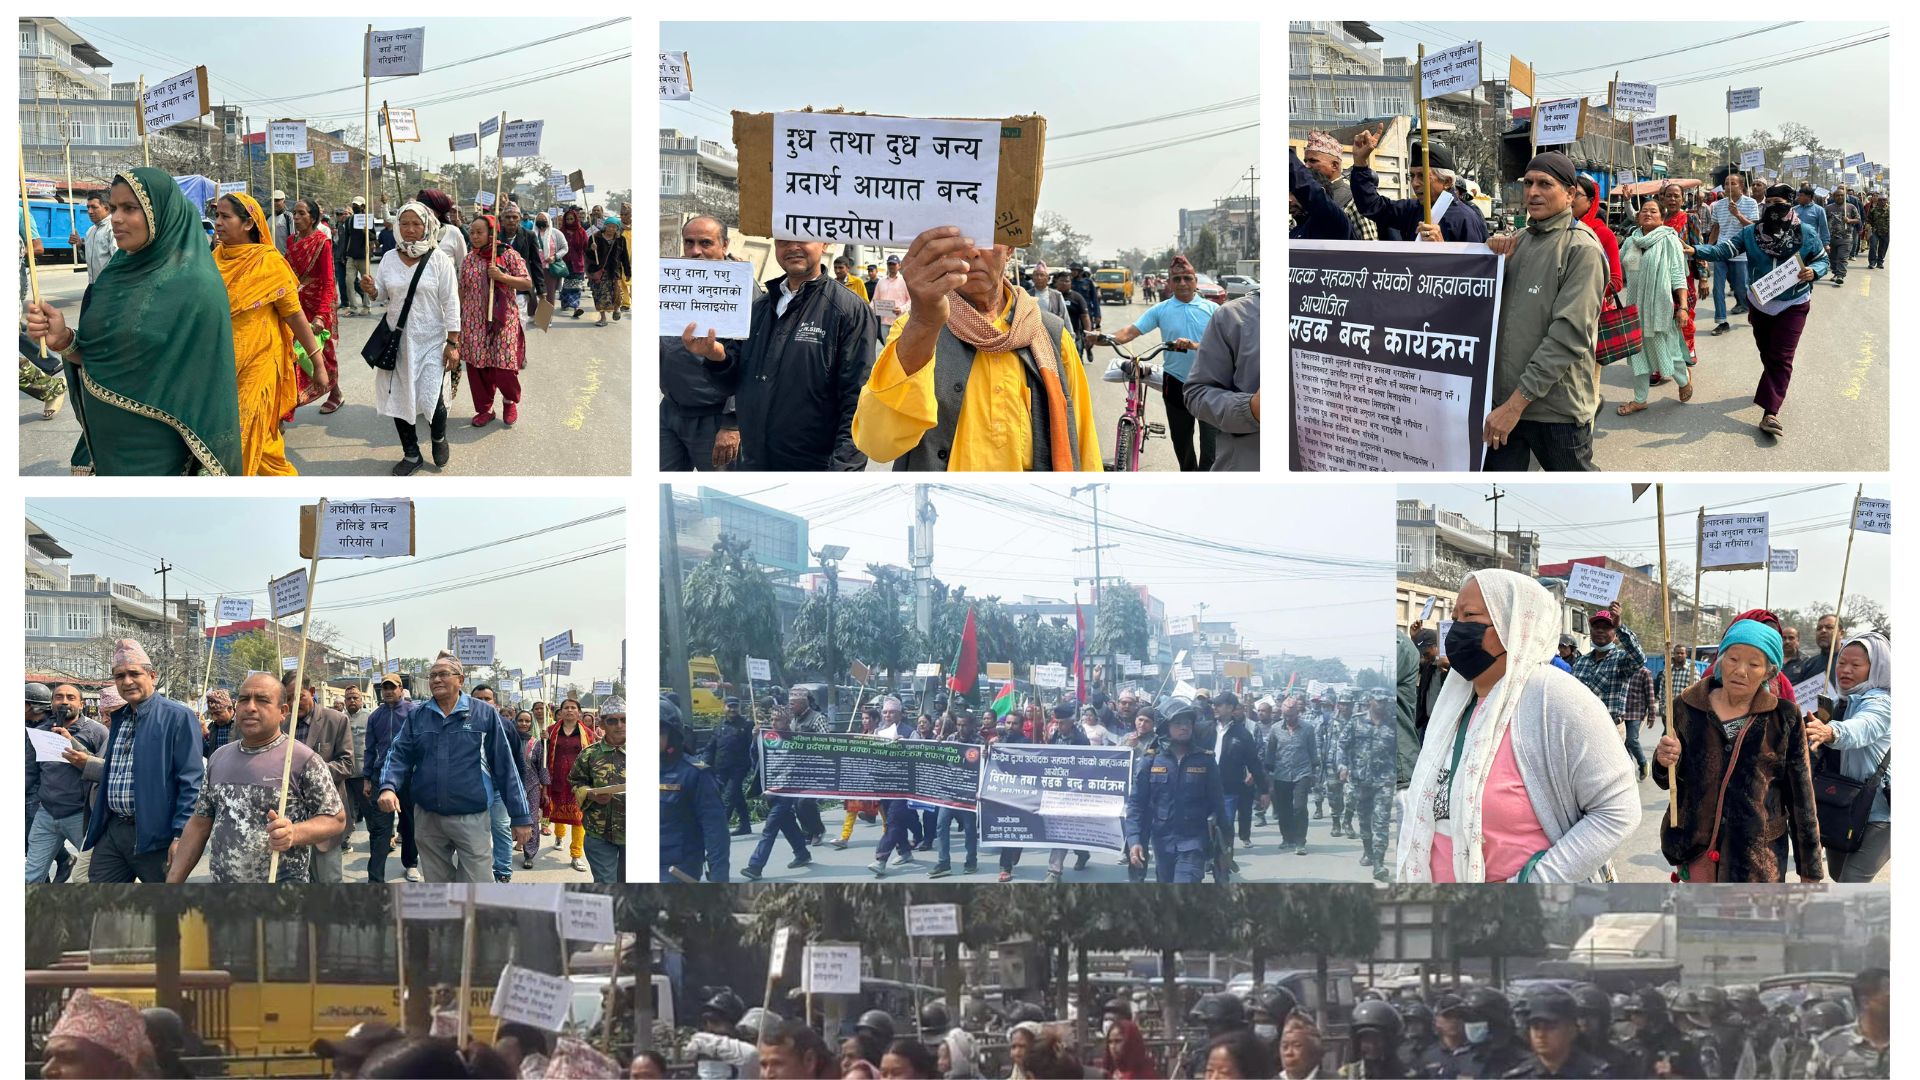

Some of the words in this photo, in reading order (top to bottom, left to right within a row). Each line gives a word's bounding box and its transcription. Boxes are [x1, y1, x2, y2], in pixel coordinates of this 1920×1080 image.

[394, 45, 407, 53] लागु
[153, 86, 165, 98] तथा
[168, 82, 177, 95] दुध
[161, 96, 180, 108] आयात
[786, 128, 816, 159] दुध
[829, 130, 875, 155] तथा
[886, 134, 921, 165] दुध
[932, 136, 982, 161] जन्य
[854, 176, 924, 201] आयात
[937, 180, 982, 204] बन्द
[664, 268, 681, 281] पशु
[686, 268, 709, 281] दाना,
[714, 270, 731, 283] पशु
[1320, 266, 1370, 289] सहकारी
[1371, 267, 1413, 293] संघको
[1417, 274, 1496, 299] आह्वानमा
[698, 285, 742, 299] अनुदानको
[690, 299, 738, 313] मिलाइयोस
[1300, 290, 1350, 317] आयोजित
[1288, 315, 1333, 342] सडक
[1339, 321, 1375, 355] बन्द
[1384, 321, 1480, 366] कार्यक्रम
[1420, 384, 1442, 401] मिलाउनु
[1444, 390, 1454, 400] पर्ने
[329, 503, 366, 515] अघोषीत
[371, 503, 397, 515] मिल्क
[336, 518, 366, 531] होलिडे
[370, 521, 389, 531] बन्द
[1736, 516, 1765, 524] आधारमा
[1703, 530, 1718, 539] धको
[1721, 528, 1744, 539] अनुदान
[1747, 527, 1764, 535] रकम
[339, 535, 374, 548] गरियोस
[781, 740, 804, 749] विरोध
[1025, 754, 1049, 764] उत्पादक
[1050, 755, 1076, 766] सहकारी
[1077, 755, 1097, 766] संघको
[1044, 765, 1070, 777] आयोजित
[989, 769, 1017, 786] विरोध
[1020, 774, 1038, 786] तथा
[1041, 776, 1063, 788] सडक
[1067, 777, 1084, 791] बन्द
[1088, 776, 1126, 792] कार्यक्रम
